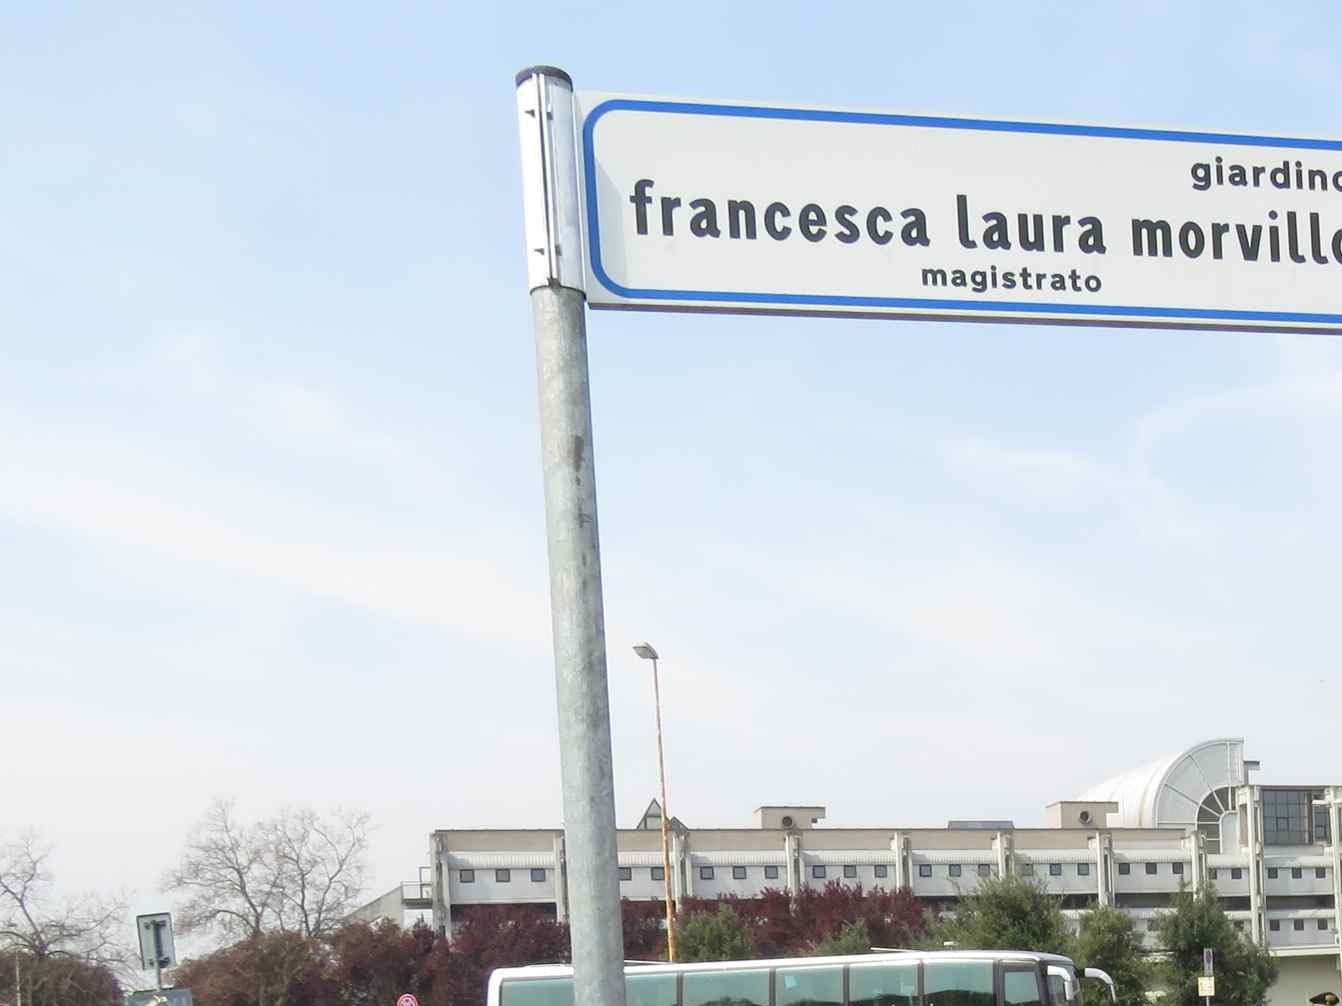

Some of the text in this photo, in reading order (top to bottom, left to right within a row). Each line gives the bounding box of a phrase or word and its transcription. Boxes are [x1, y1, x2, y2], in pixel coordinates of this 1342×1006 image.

[630, 178, 931, 247] francesca
[957, 194, 1107, 255] laura
[922, 264, 1102, 294] magistrato
